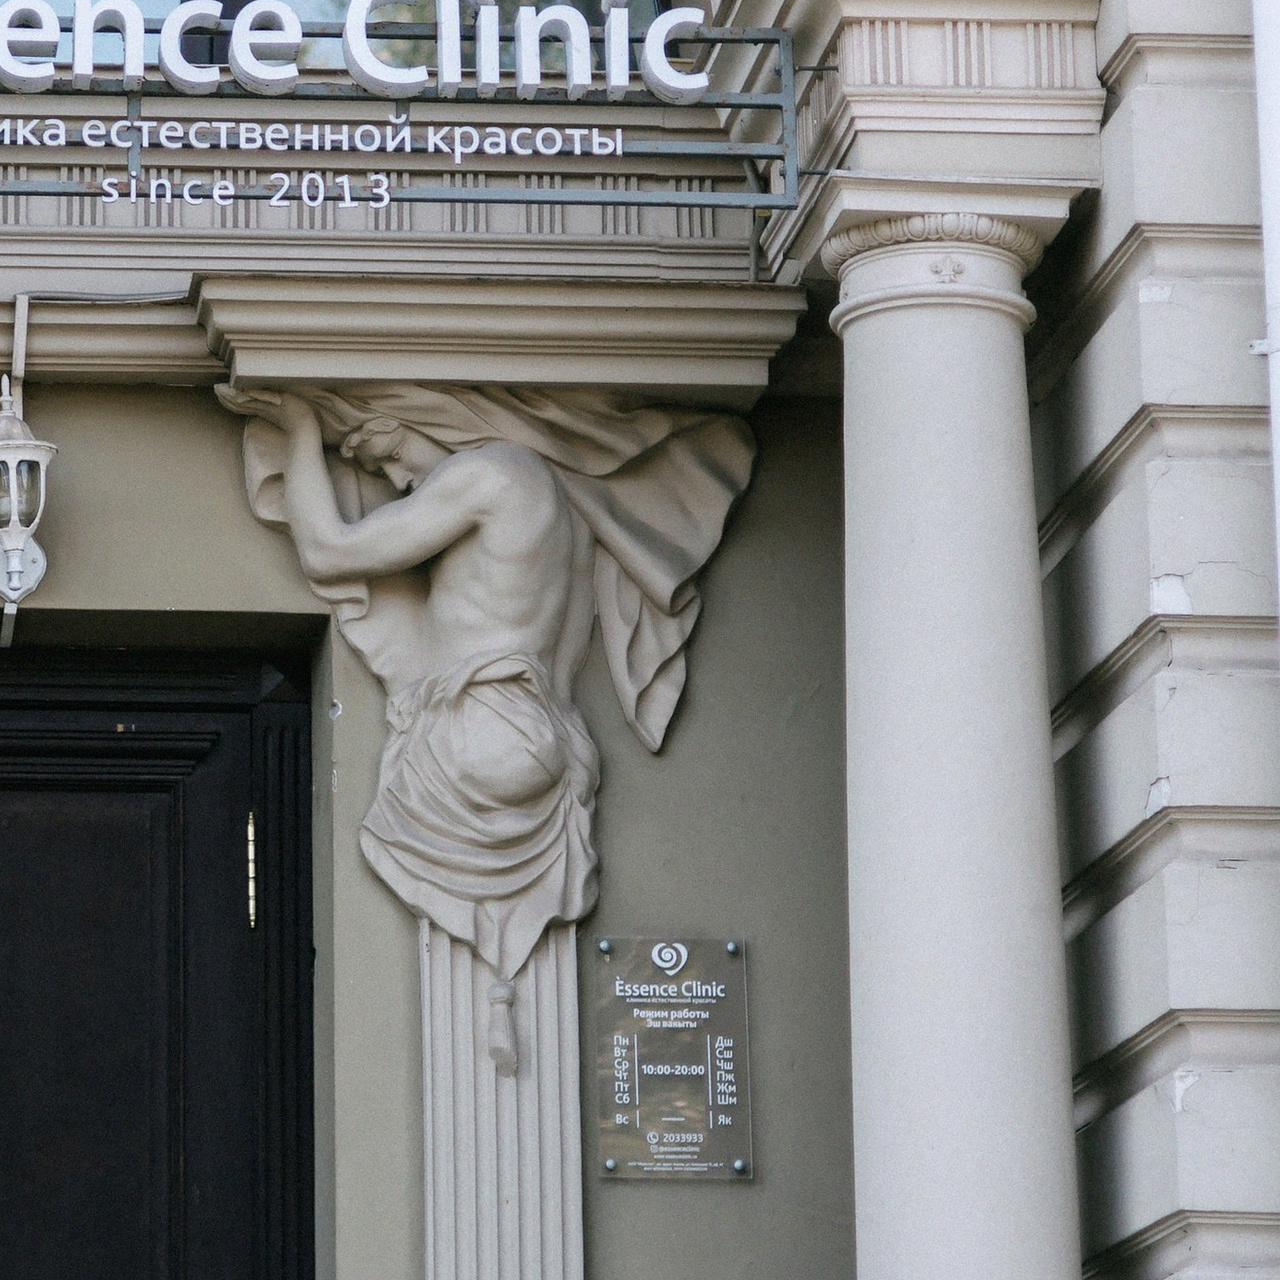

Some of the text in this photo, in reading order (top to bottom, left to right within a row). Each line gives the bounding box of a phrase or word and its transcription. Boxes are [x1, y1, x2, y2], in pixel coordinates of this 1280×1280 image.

[81, 113, 412, 152] естественной
[426, 123, 624, 165] красоты
[100, 170, 392, 209] since 2013
[681, 980, 726, 997] Clinic
[633, 1008, 710, 1020] Режим работы
[646, 1019, 661, 1028] Эш
[614, 1035, 630, 1045] Пн
[715, 1035, 734, 1049] Дш
[614, 1046, 628, 1057] Вт
[715, 1048, 733, 1059] Сш
[614, 1058, 630, 1071] Ср
[641, 1064, 705, 1075] 10:00-20:00
[716, 1059, 734, 1070] Чш
[614, 1070, 629, 1080] Чт
[615, 1081, 630, 1092] Пт
[615, 1093, 630, 1104] Сб
[717, 1094, 738, 1105] Шм
[616, 1114, 629, 1124] Вс
[718, 1114, 732, 1125] Як
[663, 1133, 703, 1143] 2033933
